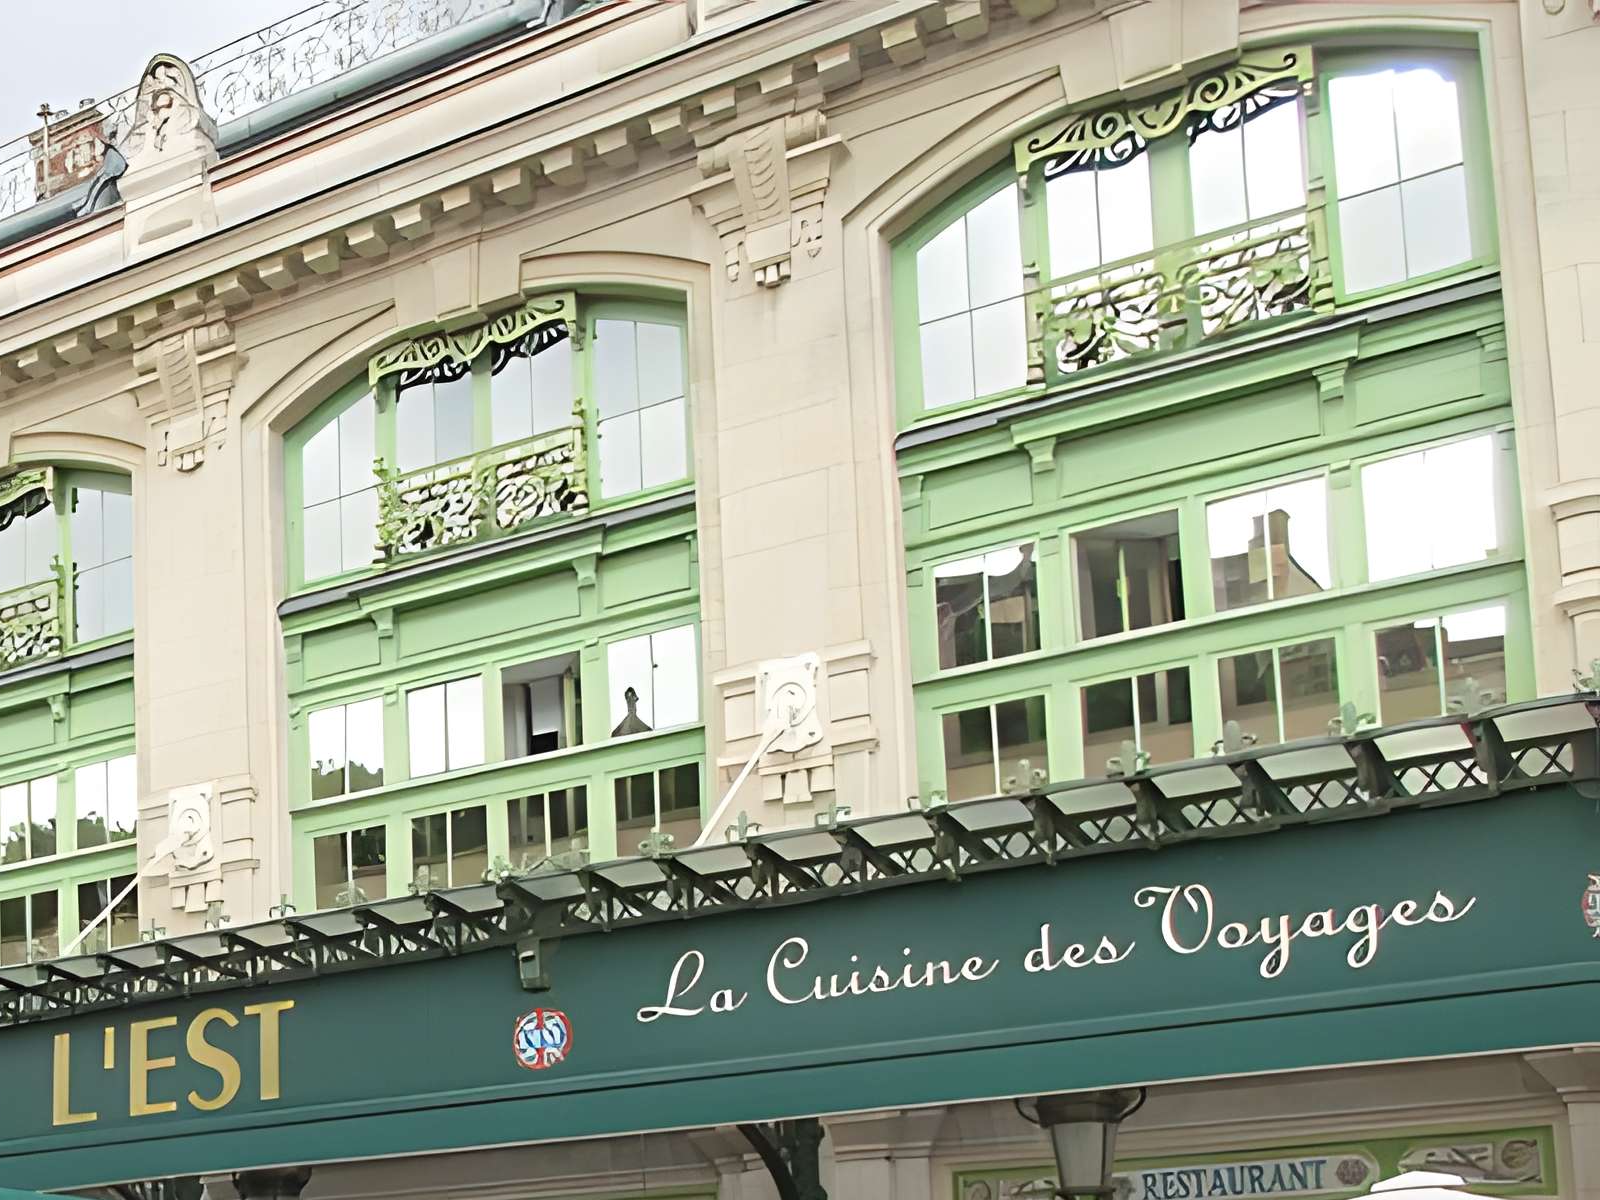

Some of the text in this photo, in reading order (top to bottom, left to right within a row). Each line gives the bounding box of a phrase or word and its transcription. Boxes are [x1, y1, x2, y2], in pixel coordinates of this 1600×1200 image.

[636, 883, 1477, 1023] La Cuisine des Voyages
[52, 1000, 295, 1127] L'EST
[1141, 1159, 1328, 1200] RESTAURANT
